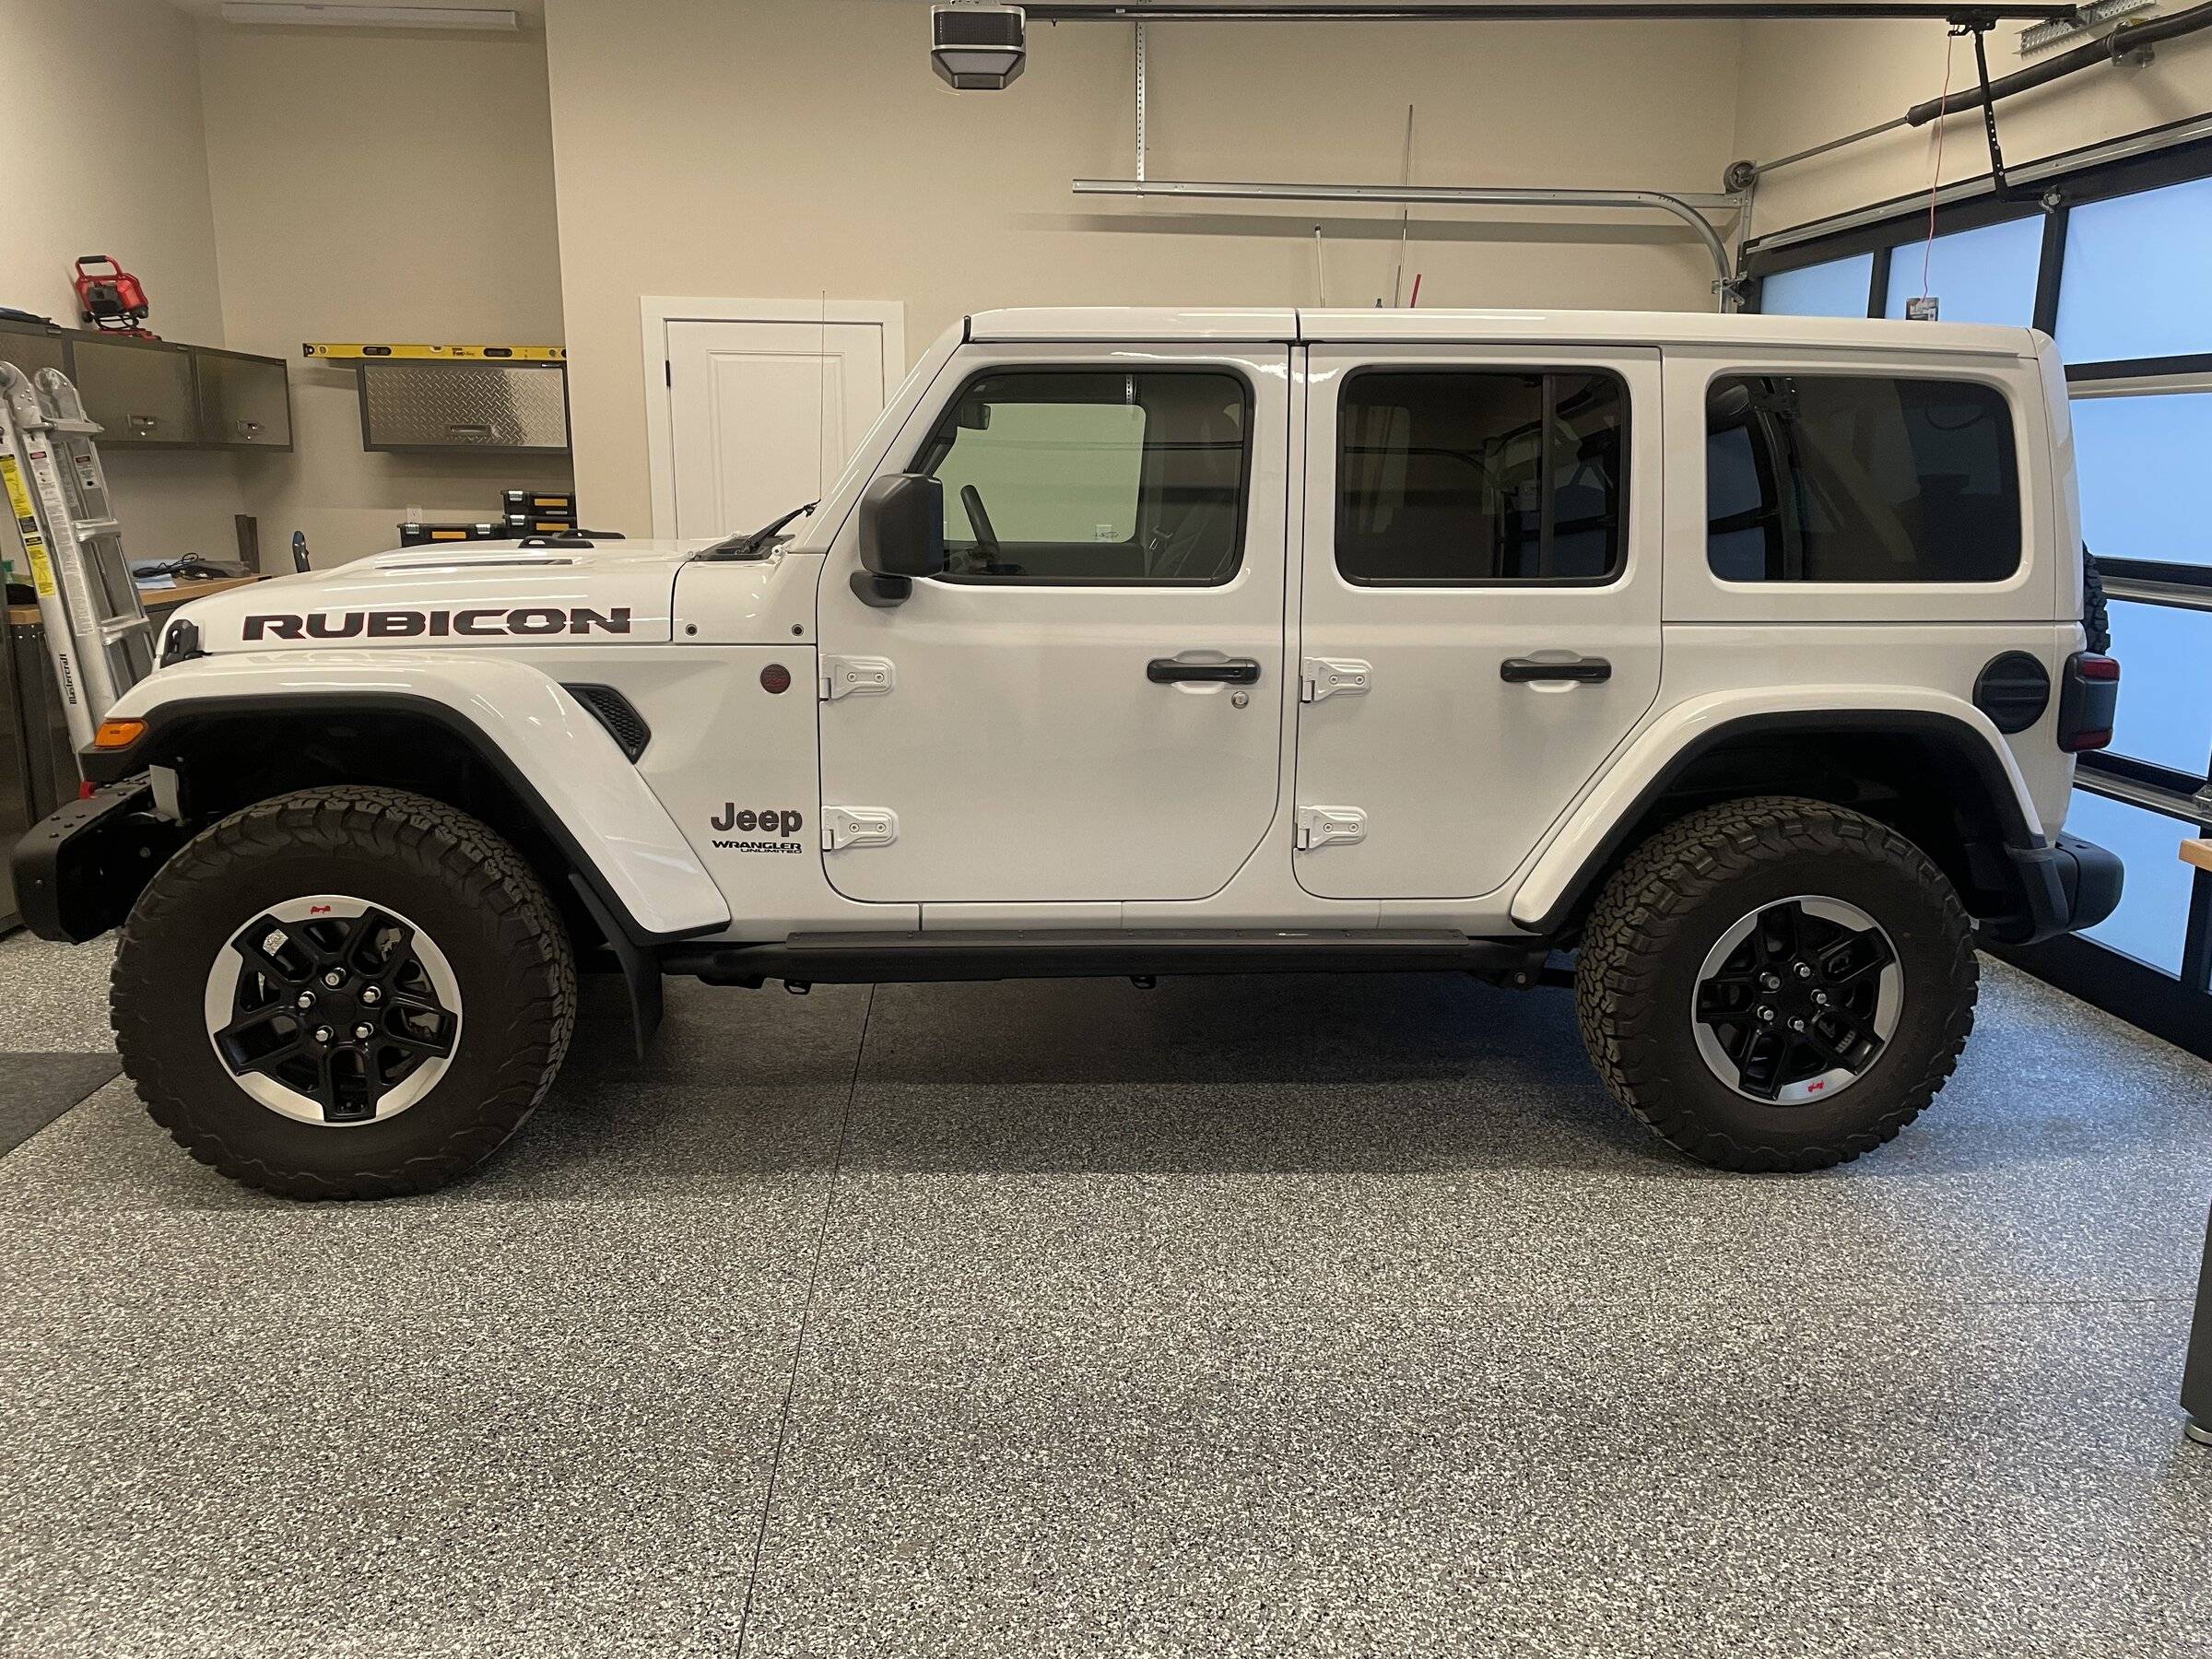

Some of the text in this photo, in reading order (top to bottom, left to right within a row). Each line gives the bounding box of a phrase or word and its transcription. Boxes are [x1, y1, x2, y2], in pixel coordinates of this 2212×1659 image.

[242, 607, 631, 641] RUBICON
[711, 802, 803, 837] Jeep
[712, 840, 802, 849] WRANGLER
